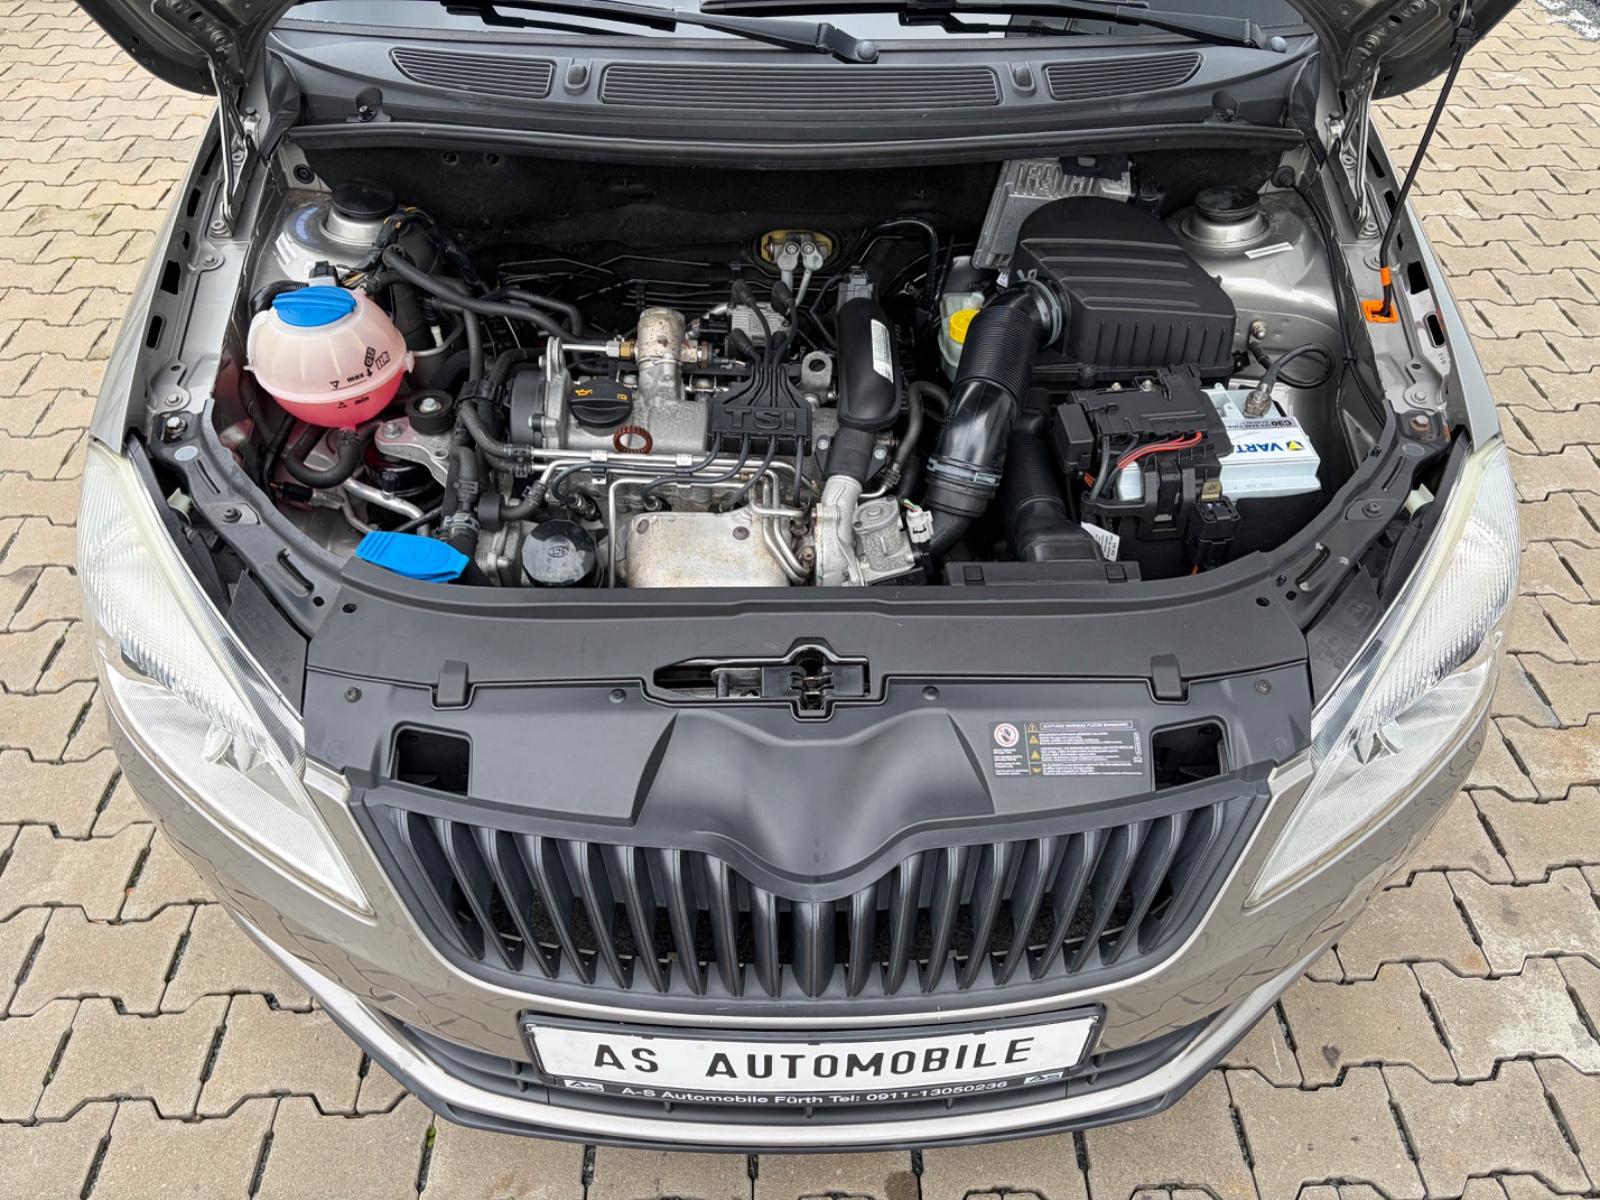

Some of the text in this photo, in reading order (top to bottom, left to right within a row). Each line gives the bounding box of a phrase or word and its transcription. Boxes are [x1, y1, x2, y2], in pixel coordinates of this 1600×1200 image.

[347, 372, 364, 382] max
[354, 396, 369, 404] min
[724, 408, 796, 430] TSI
[1235, 442, 1284, 454] VART
[594, 1036, 1035, 1079] AS AUTOMOBILE
[621, 1080, 1008, 1104] A-S Automobile Fürth Tel: 0911-13050236
